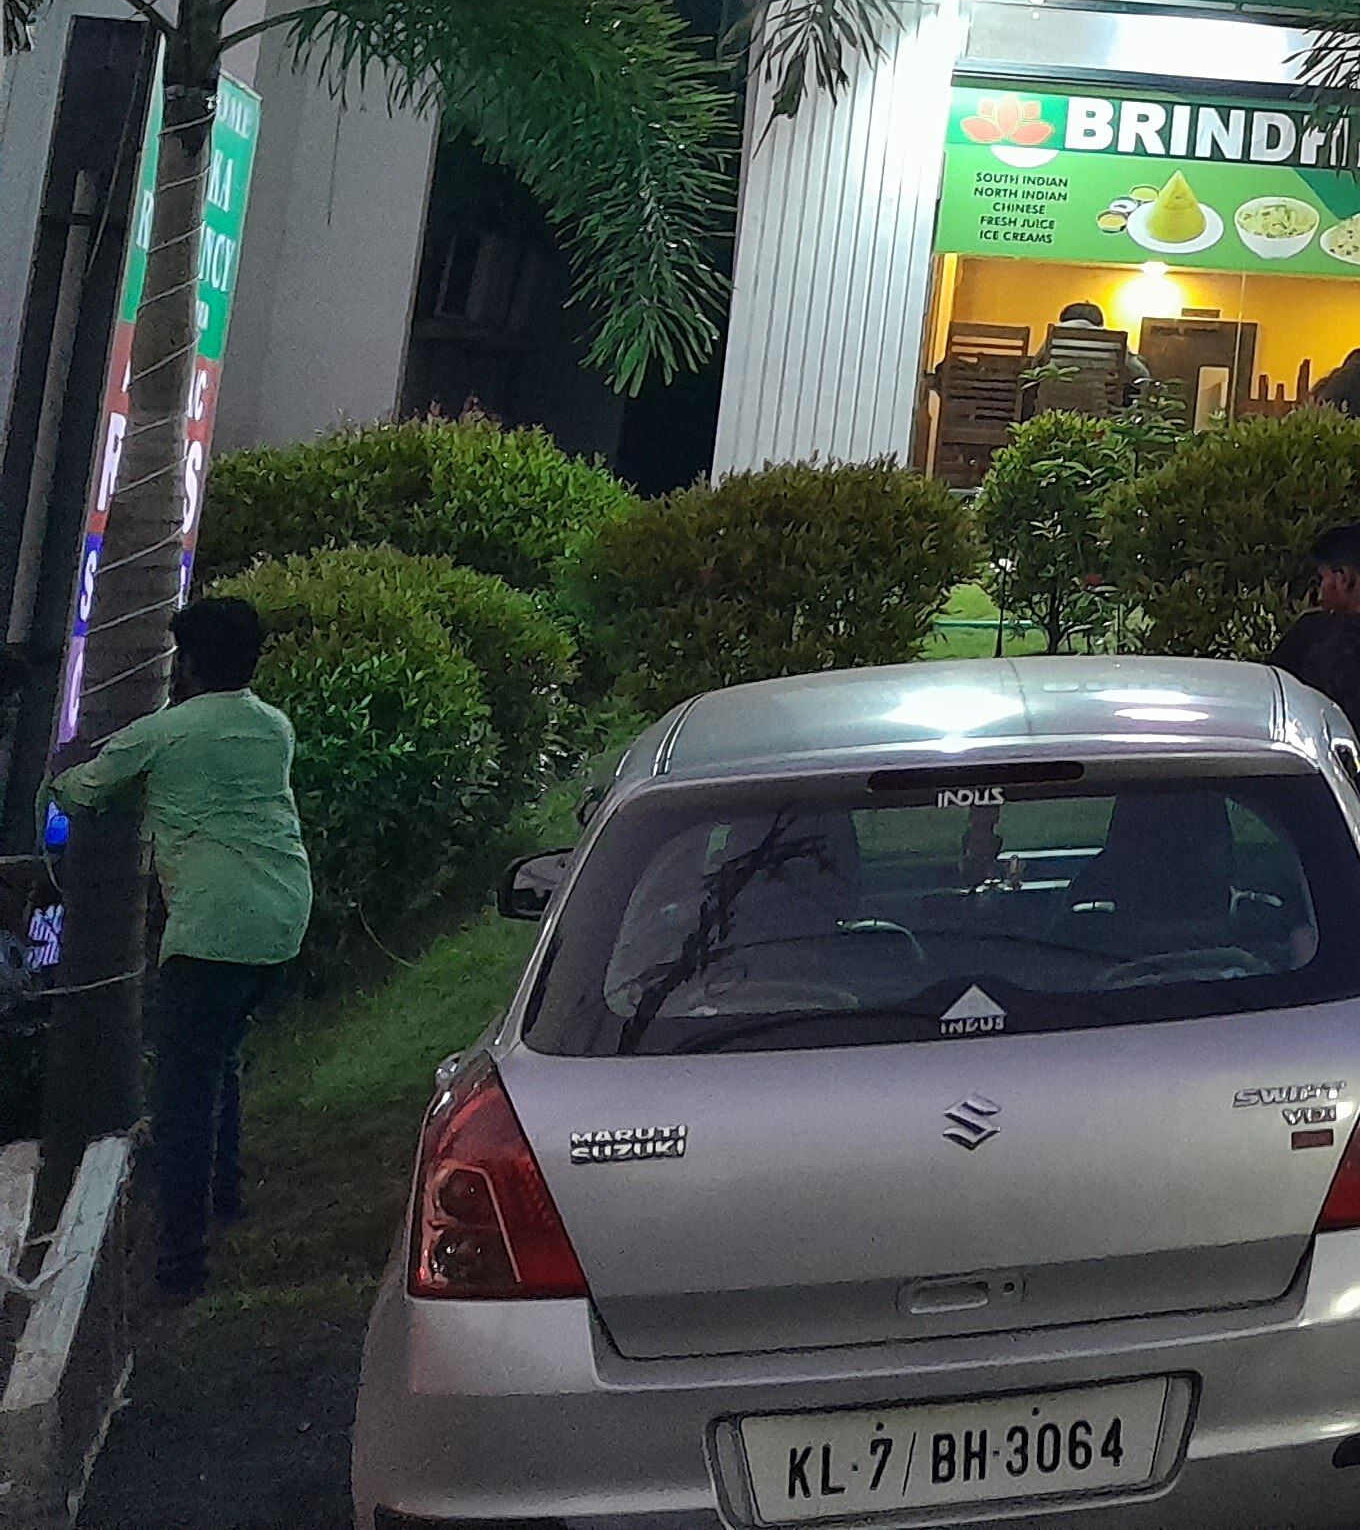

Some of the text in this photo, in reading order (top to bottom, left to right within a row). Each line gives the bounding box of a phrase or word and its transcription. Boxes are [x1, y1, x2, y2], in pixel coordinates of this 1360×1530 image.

[976, 172, 1068, 188] SOUTH INDIAN
[974, 187, 1067, 201] NORTH INDIAN
[993, 202, 1045, 214] CHINESE
[980, 216, 1055, 230] FRESH JUICE
[980, 230, 1052, 244] ICE CREAMS
[937, 787, 1005, 809] INDUS
[939, 1017, 1005, 1035] INDUS
[1233, 1080, 1346, 1107] SWIFT
[571, 1124, 687, 1144] MARUTI
[571, 1139, 685, 1161] SUZUKI
